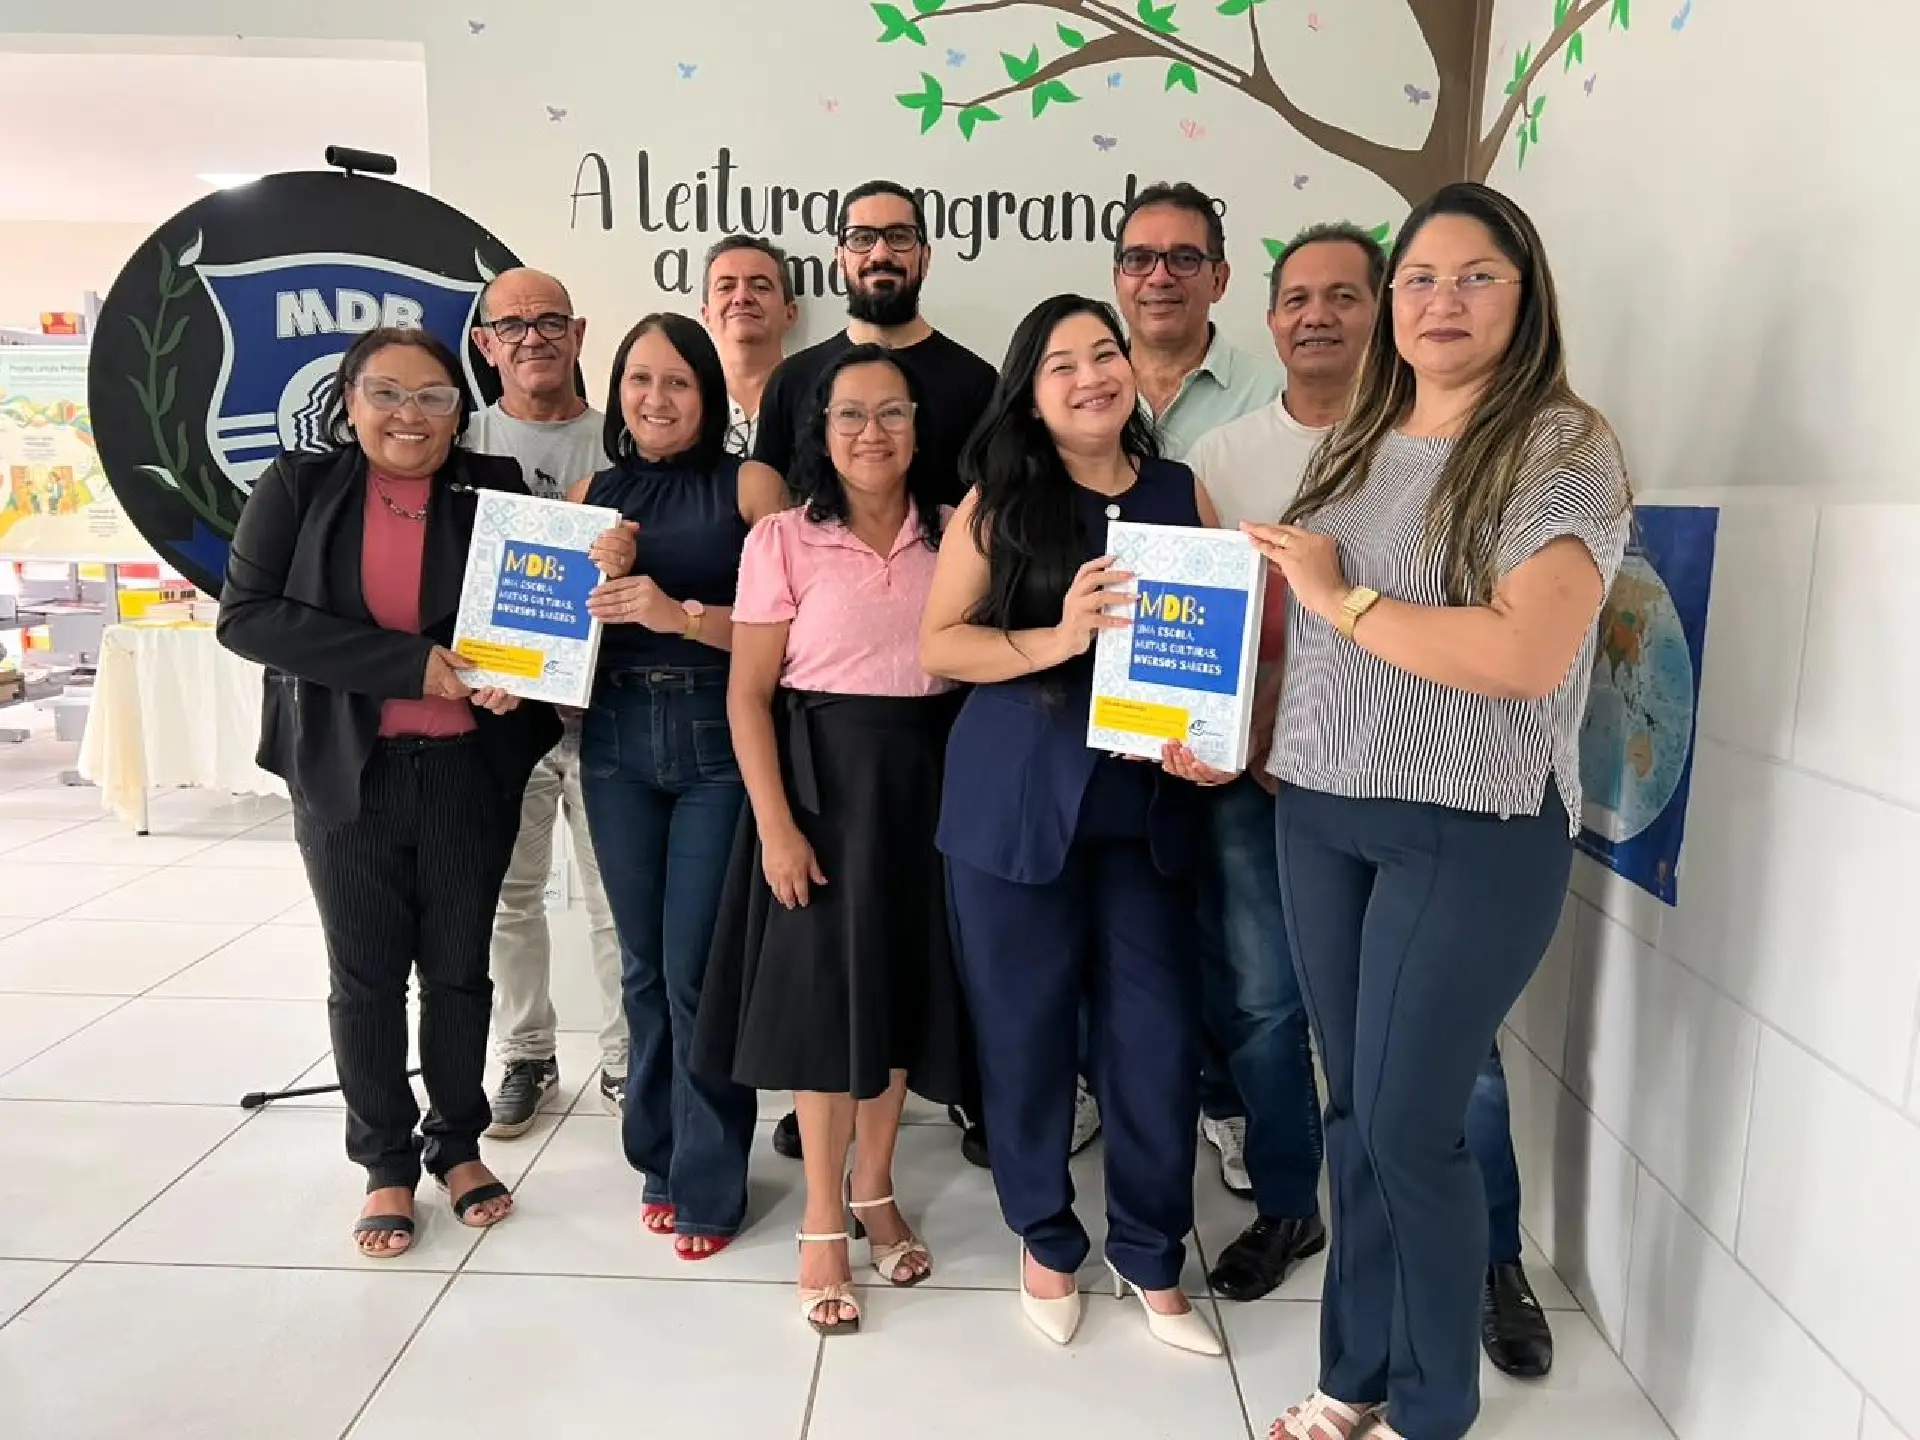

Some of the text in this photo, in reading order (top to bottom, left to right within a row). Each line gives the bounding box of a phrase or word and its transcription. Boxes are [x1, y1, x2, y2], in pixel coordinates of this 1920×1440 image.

[570, 152, 613, 231] A
[654, 248, 693, 294] a
[276, 288, 423, 339] MDB
[504, 550, 565, 582] MDB:
[1140, 590, 1206, 625] MDB:
